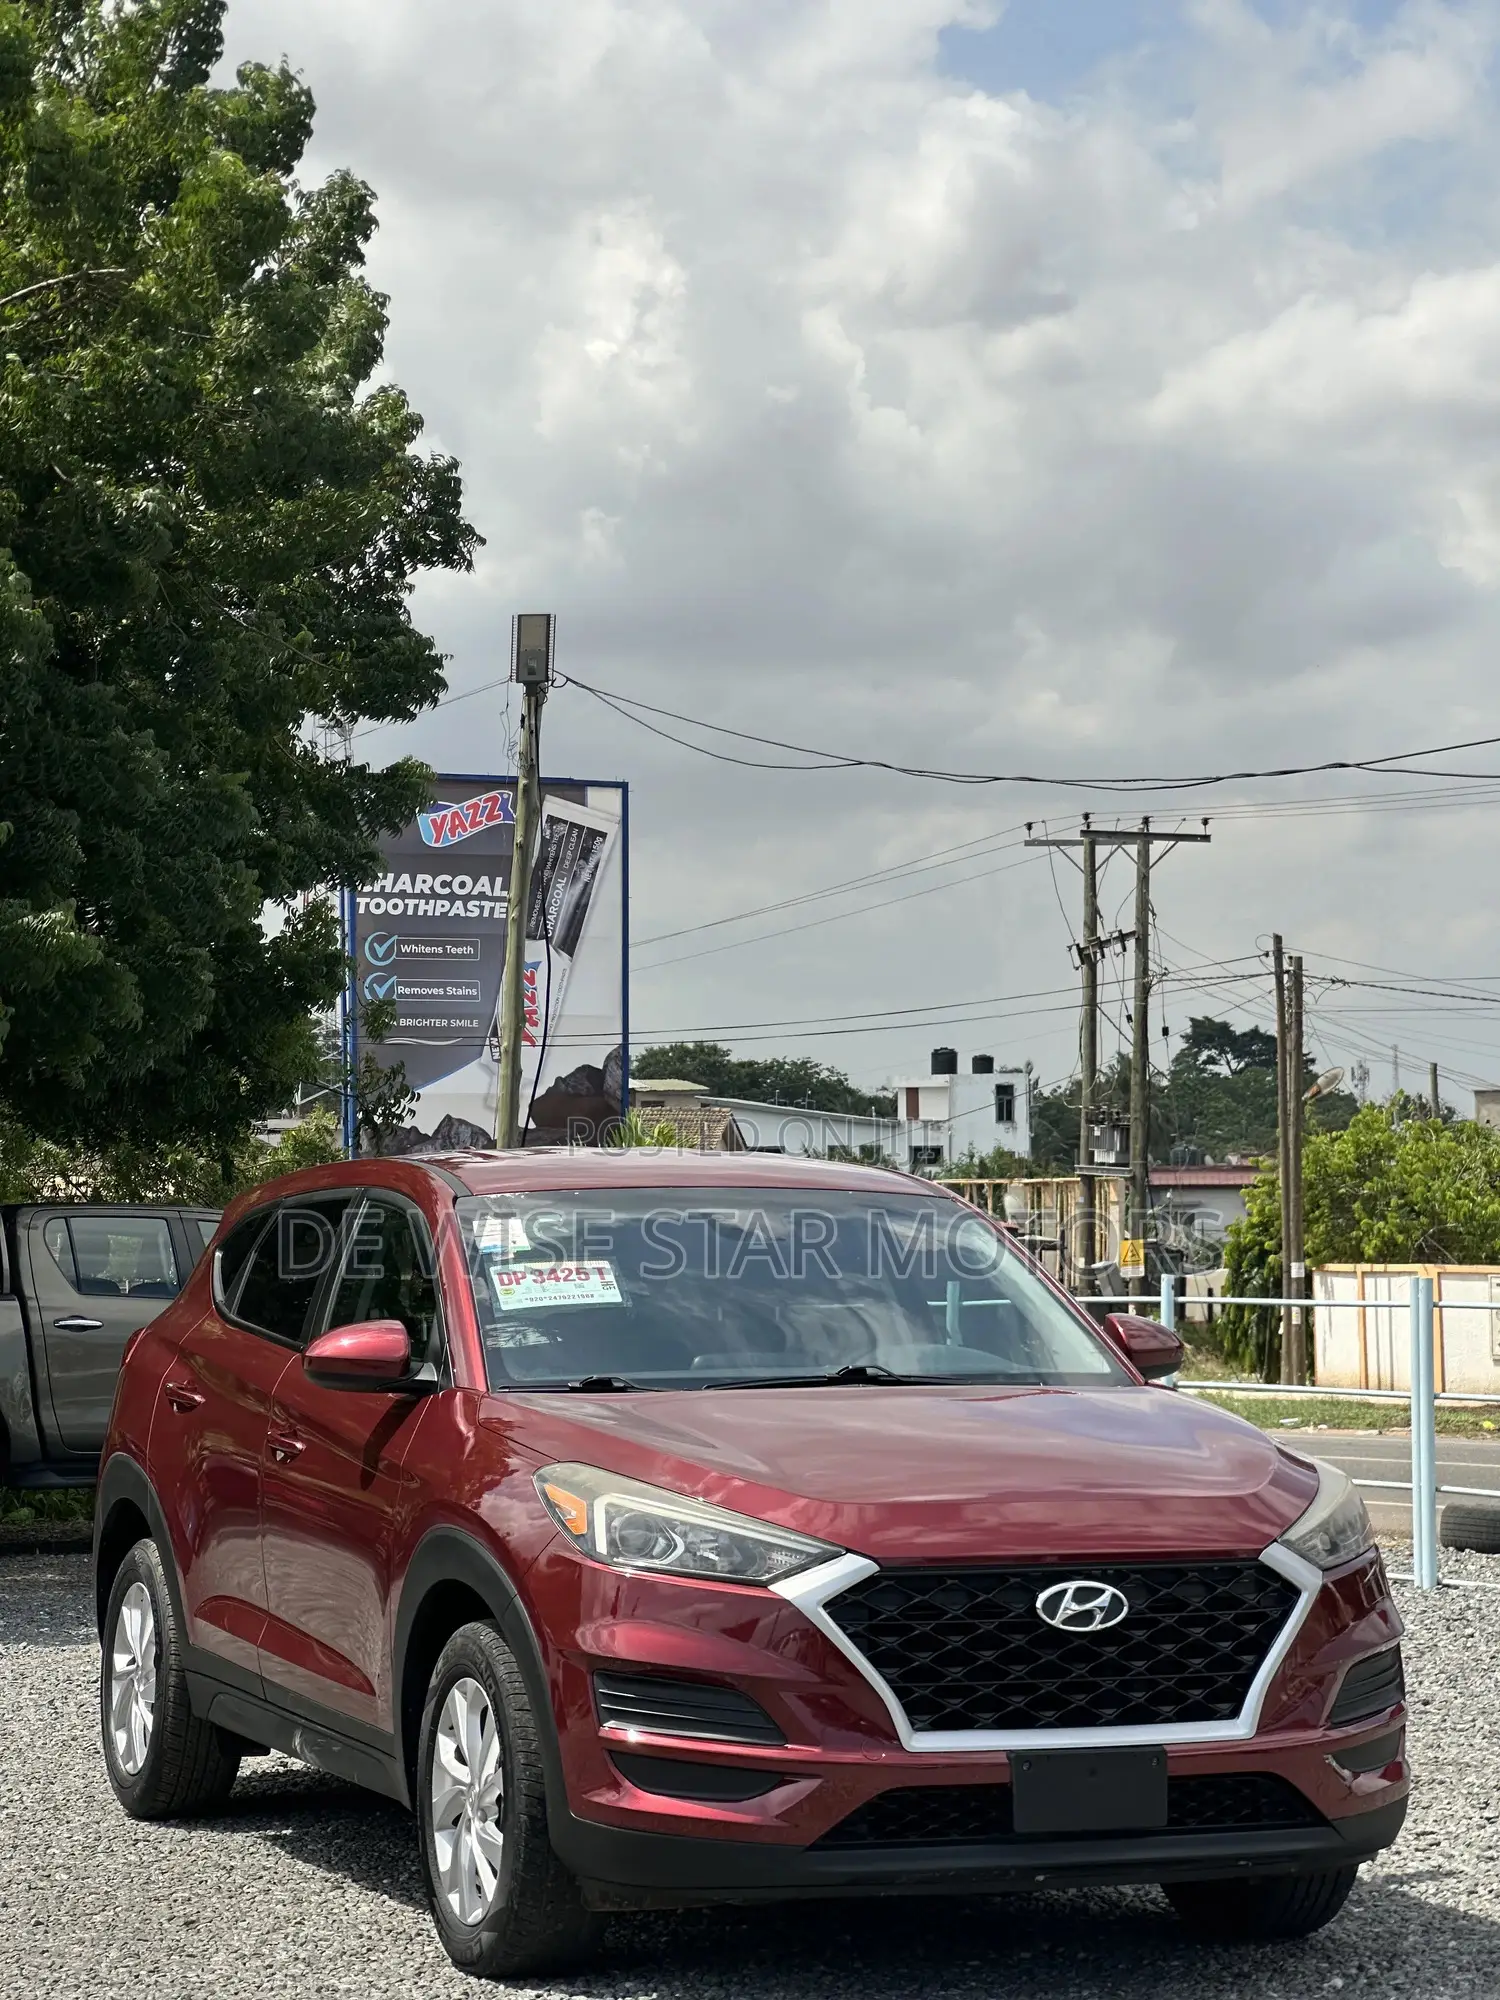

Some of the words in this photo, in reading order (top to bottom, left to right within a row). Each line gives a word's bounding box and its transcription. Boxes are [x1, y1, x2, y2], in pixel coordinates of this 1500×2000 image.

[429, 793, 503, 845] YAZZ
[563, 850, 573, 869] DEEP
[568, 828, 578, 850] CLEAN
[356, 897, 508, 919] TOOTHPASTE
[400, 944, 442, 954] Whitens
[445, 945, 474, 955] Teeth
[397, 986, 444, 995] Removes
[446, 987, 478, 996] Stains
[400, 1018, 448, 1028] BRIGHTER
[450, 1019, 479, 1028] SMILE
[497, 1271, 527, 1286] DP
[530, 1267, 591, 1284] 3425
[592, 1266, 607, 1280] T
